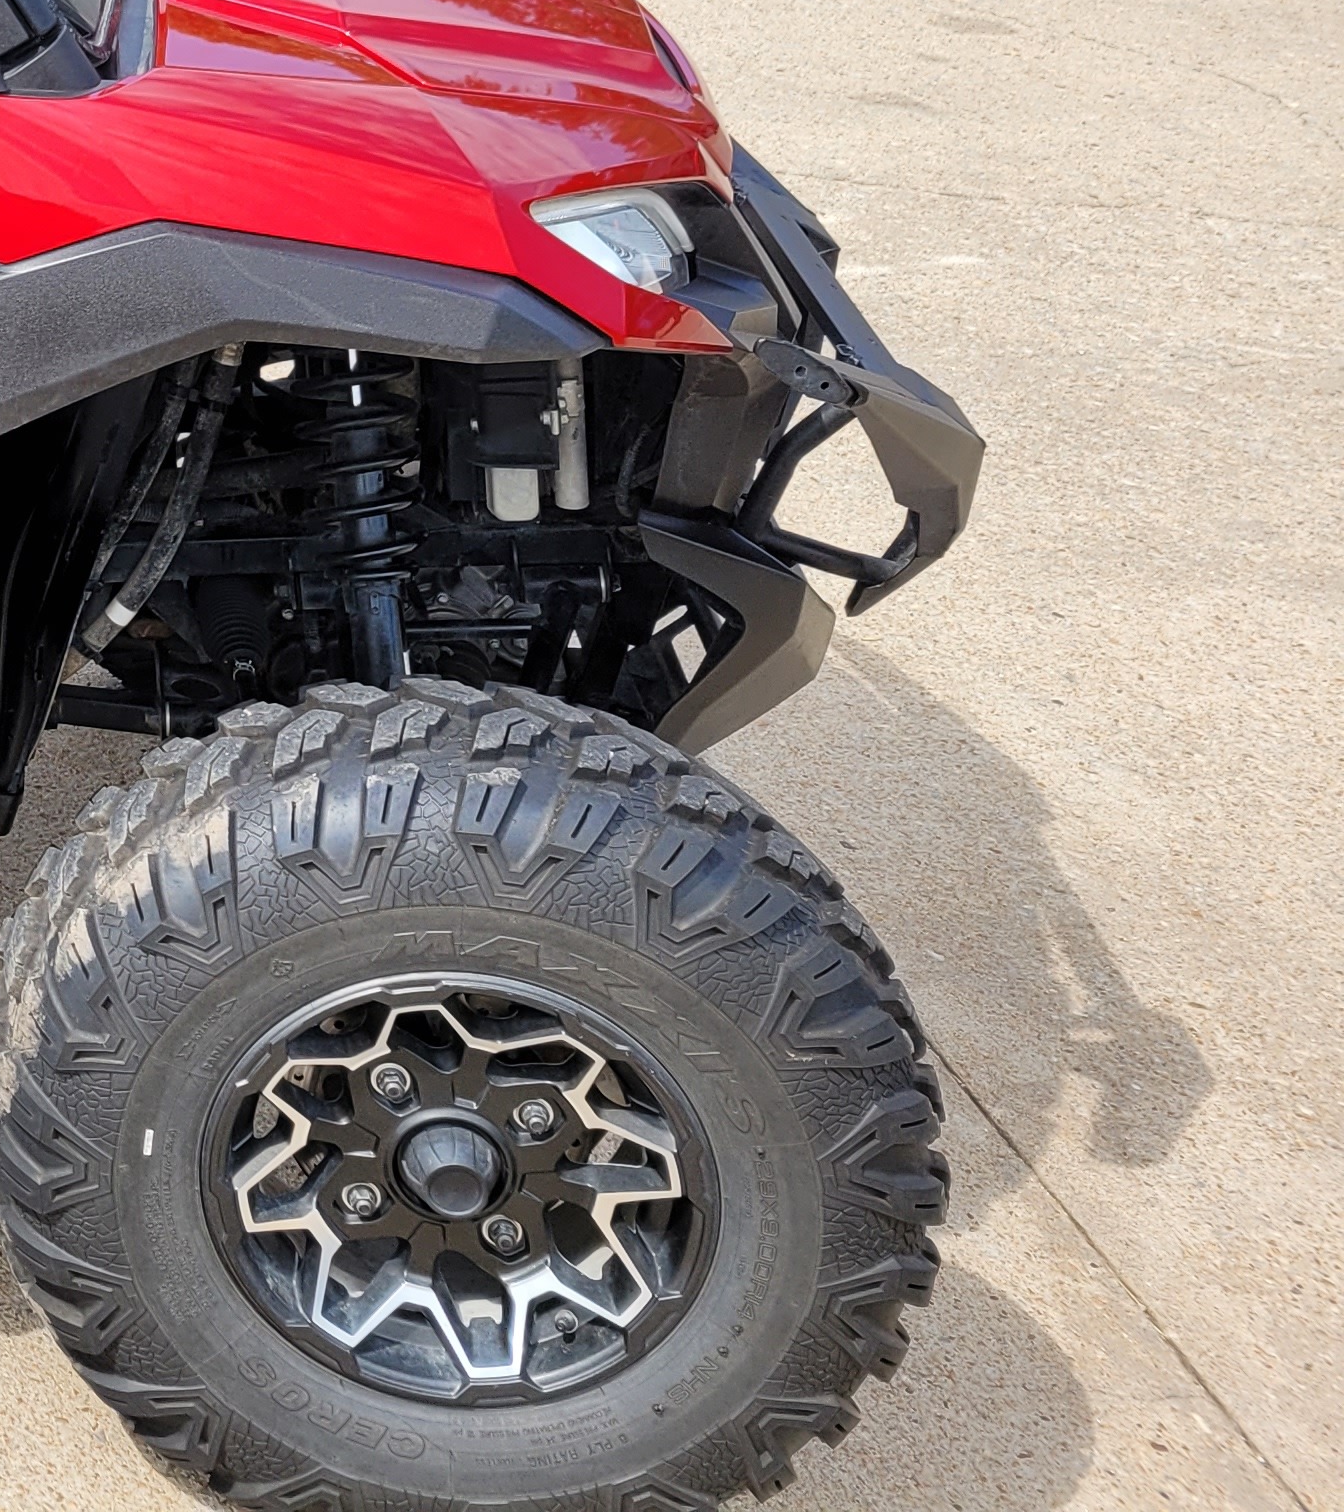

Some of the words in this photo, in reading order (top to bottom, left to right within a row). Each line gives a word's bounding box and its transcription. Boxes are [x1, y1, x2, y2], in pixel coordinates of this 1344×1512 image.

[371, 930, 769, 1137] MAXXIS
[667, 1356, 719, 1405] NHS
[238, 1356, 426, 1460] CEROS
[527, 1447, 579, 1469] RATING
[586, 1438, 614, 1458] PLY
